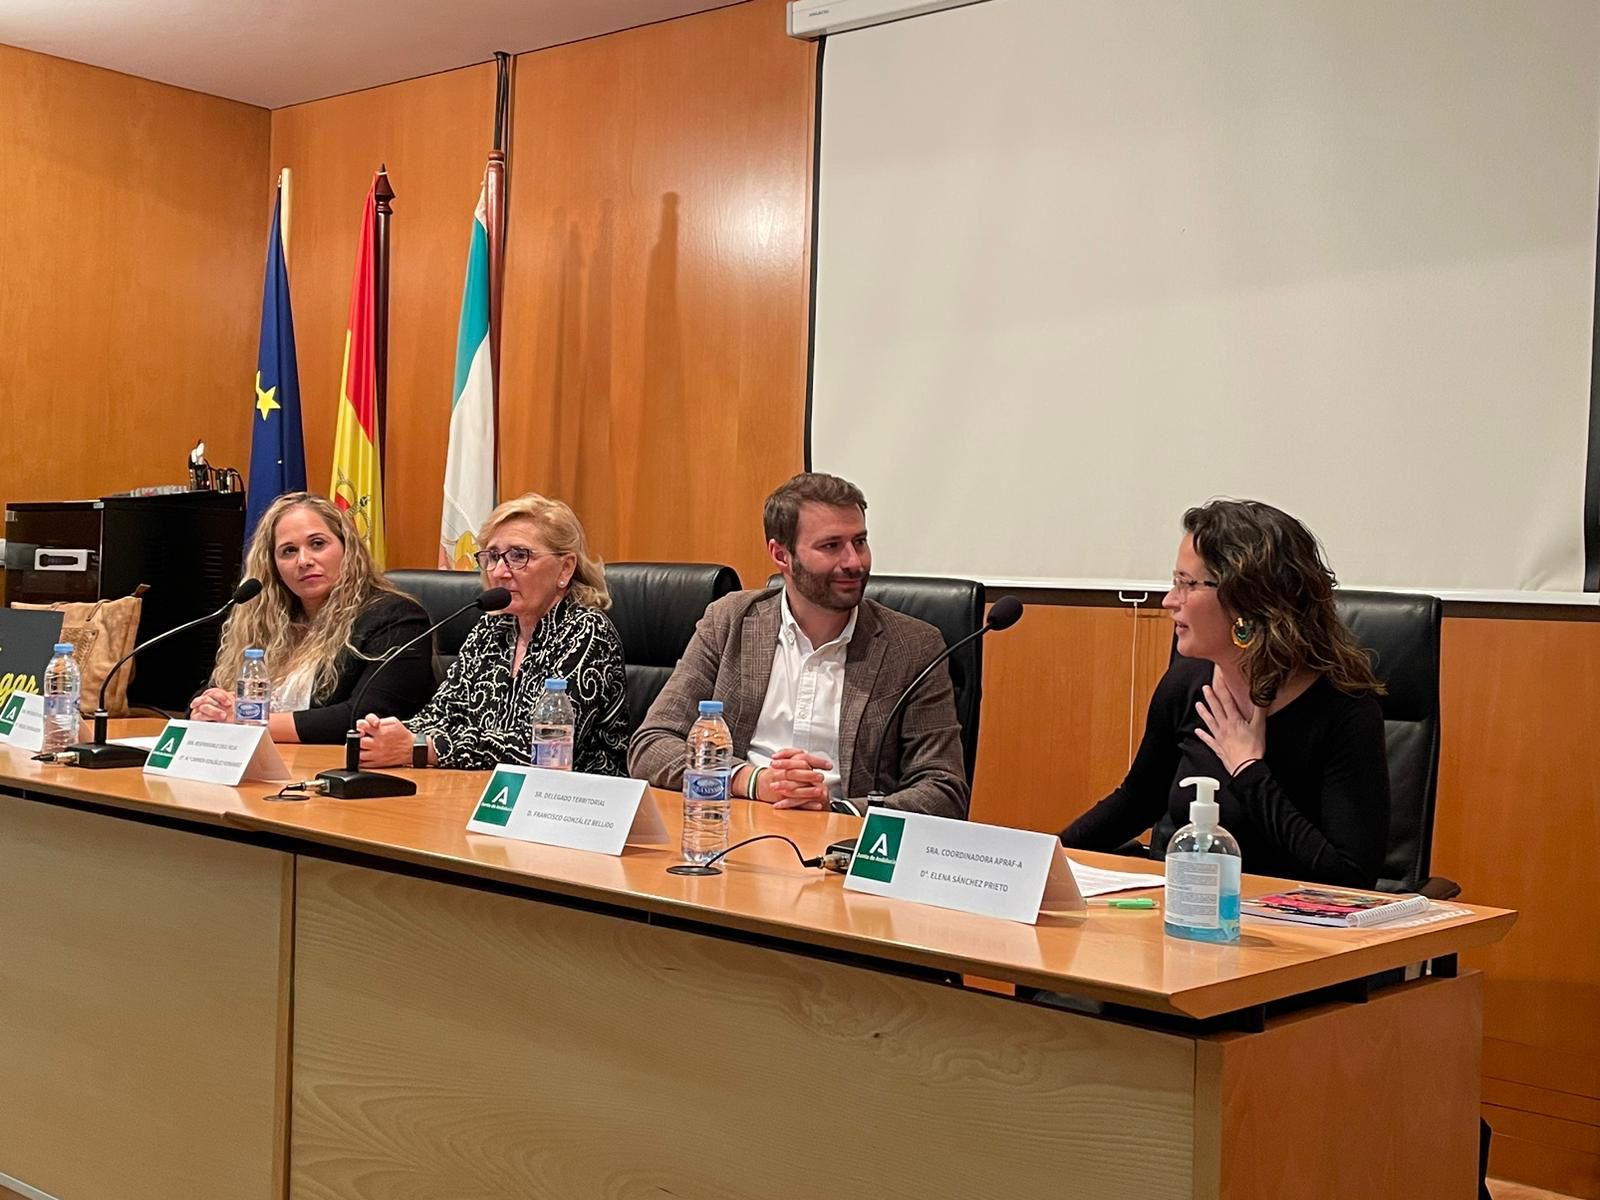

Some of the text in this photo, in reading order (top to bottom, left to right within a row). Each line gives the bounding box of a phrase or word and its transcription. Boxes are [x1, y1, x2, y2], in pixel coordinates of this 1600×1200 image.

[544, 792, 572, 803] DELEGADO
[572, 796, 606, 807] TERRITORIAL
[533, 811, 563, 822] FRANCISCO
[563, 814, 591, 826] GONZÁLEZ
[591, 818, 615, 829] BELLIDO
[926, 846, 1023, 869] SRA. COORDINADORA APRAF-A
[930, 871, 951, 882] ELENA
[952, 873, 983, 888] SÁNCHEZ
[983, 879, 1009, 893] PRIETO
